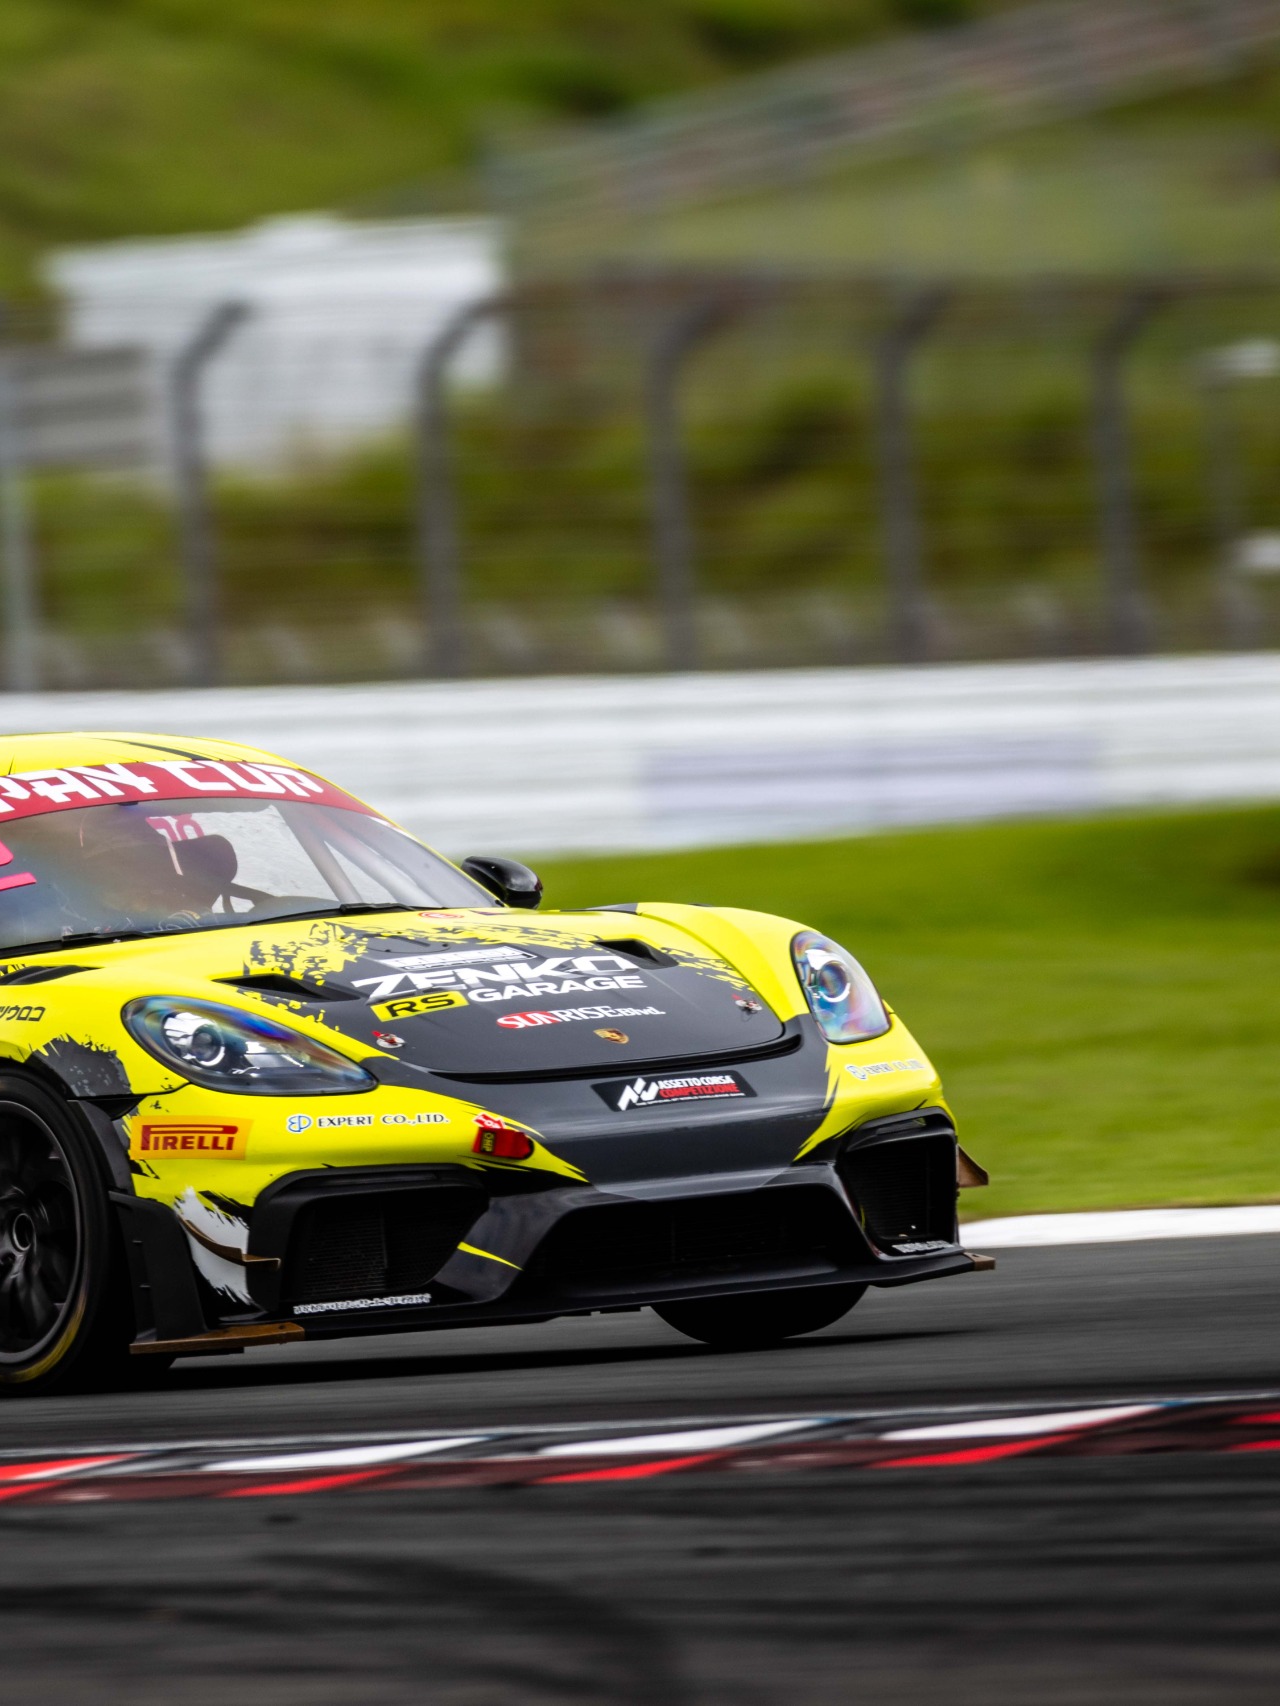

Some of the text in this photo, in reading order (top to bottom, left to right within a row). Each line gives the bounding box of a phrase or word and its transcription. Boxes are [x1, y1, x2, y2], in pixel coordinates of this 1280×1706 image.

[143, 760, 324, 797] CUP
[351, 956, 640, 1005] ZENKO
[385, 975, 648, 1018] RS GARAGE
[658, 1075, 735, 1090] ASSETTO CORSA
[659, 1083, 740, 1098] COMPETIZIONE
[318, 1115, 373, 1127] EXPERT
[141, 1125, 239, 1151] PIRELLI
